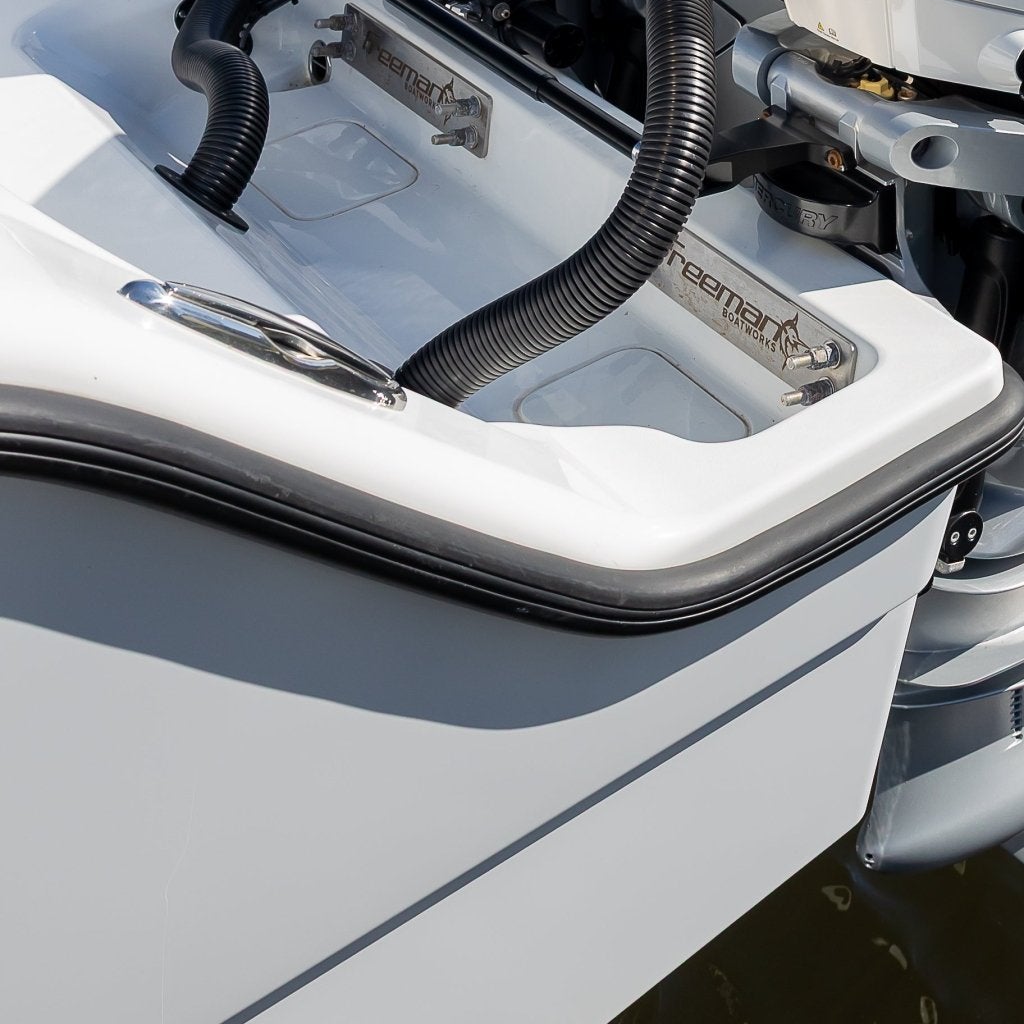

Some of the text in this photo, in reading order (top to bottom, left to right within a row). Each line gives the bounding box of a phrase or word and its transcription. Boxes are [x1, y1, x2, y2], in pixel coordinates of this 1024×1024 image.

[404, 82, 436, 110] BOATWORK
[667, 239, 783, 342] reeman
[722, 307, 777, 353] BOATWORKS
